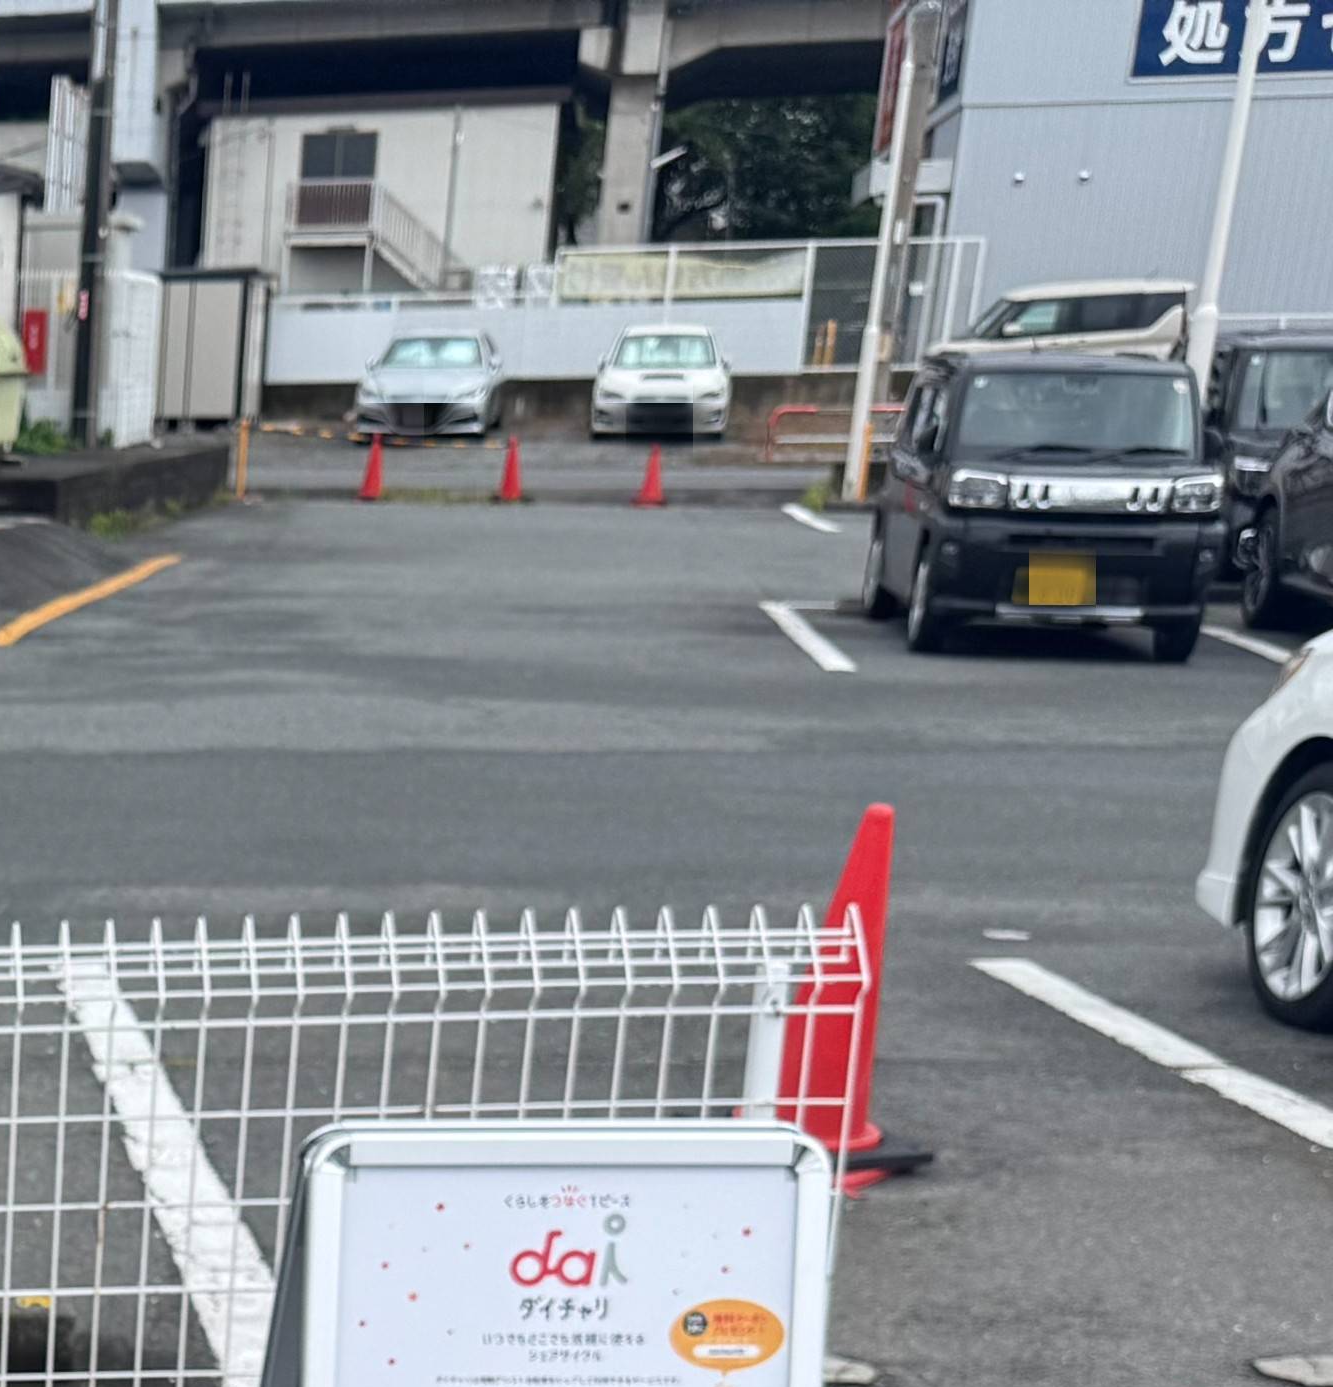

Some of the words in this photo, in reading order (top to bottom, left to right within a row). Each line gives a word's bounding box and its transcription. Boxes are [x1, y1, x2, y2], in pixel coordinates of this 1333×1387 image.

[1158, 0, 1333, 67] 処方
[509, 1213, 629, 1288] dai
[519, 1296, 609, 1321] ダイチャリ
